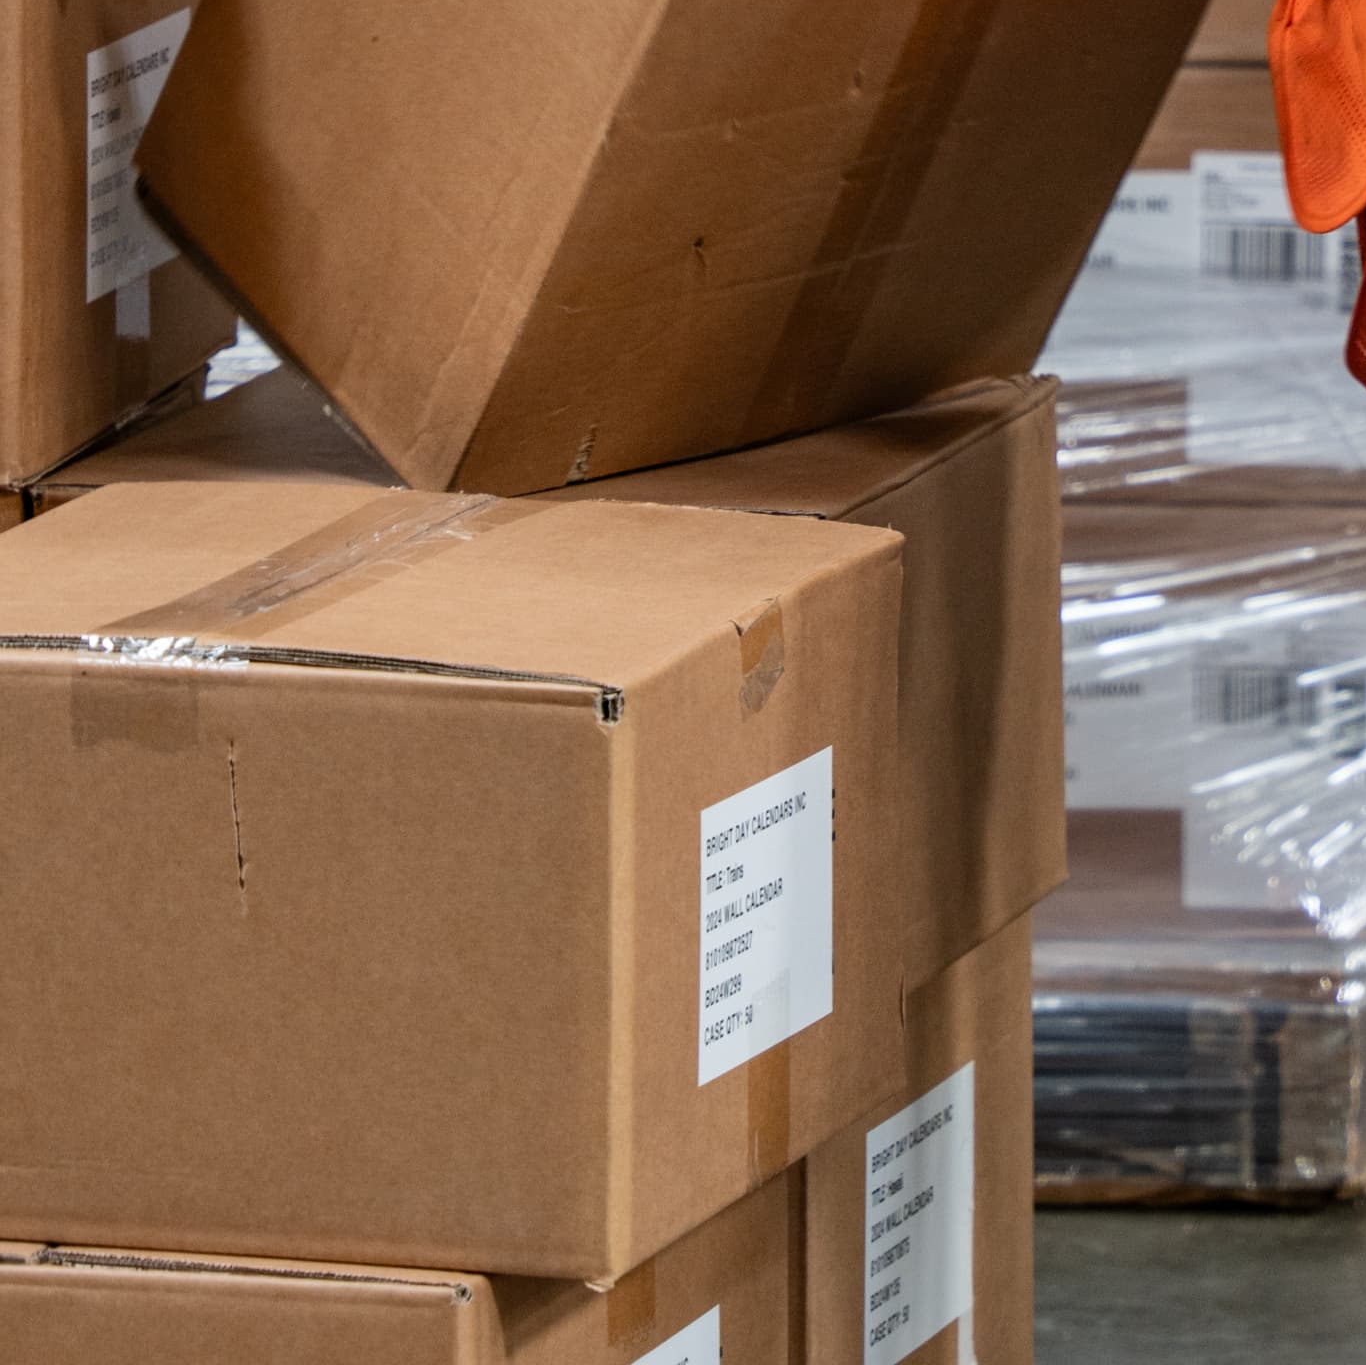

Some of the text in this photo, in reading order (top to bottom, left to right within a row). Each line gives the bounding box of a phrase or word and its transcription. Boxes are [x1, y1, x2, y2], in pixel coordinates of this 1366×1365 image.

[705, 791, 806, 857] BRIGHT DAY CALENDARS INC
[726, 859, 743, 885] Trains
[705, 876, 783, 933] 2024 WALL CALENDAR
[704, 929, 752, 971] 810109872527
[704, 973, 741, 1009] BD24W299
[703, 1019, 724, 1047] CASE
[725, 1009, 743, 1035] QTY:
[871, 1103, 953, 1174] BRIGHT DAY CALENDARS INC
[885, 1207, 902, 1232] WALL
[903, 1185, 934, 1221] CALENDAR
[869, 1319, 886, 1347] CASE
